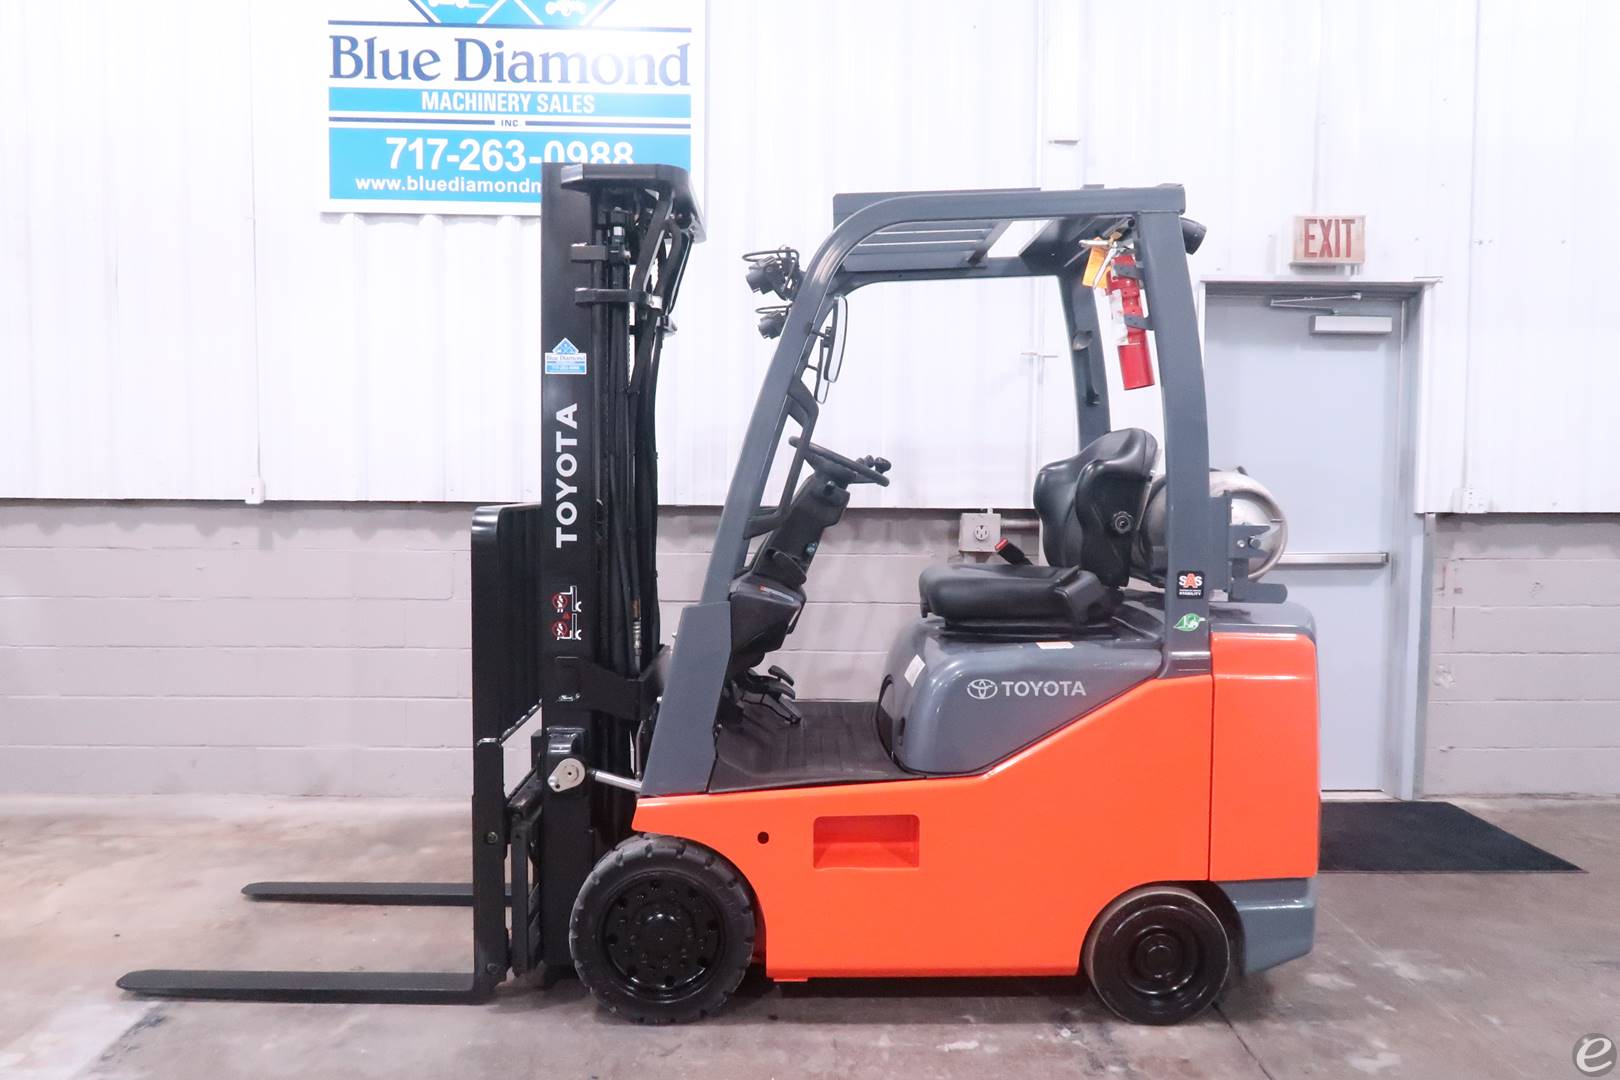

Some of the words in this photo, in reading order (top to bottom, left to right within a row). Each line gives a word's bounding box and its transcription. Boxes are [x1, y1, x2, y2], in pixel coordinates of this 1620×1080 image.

[329, 35, 441, 81] Blue
[454, 38, 691, 86] Diamond
[421, 91, 531, 112] MACHINERY
[537, 94, 595, 114] SALES
[386, 136, 634, 172] 717-263-0988
[1304, 219, 1356, 258] EXIT
[556, 403, 578, 548] TOYOTA
[1179, 573, 1203, 588] SAS
[1001, 681, 1087, 697] TOYOTA
